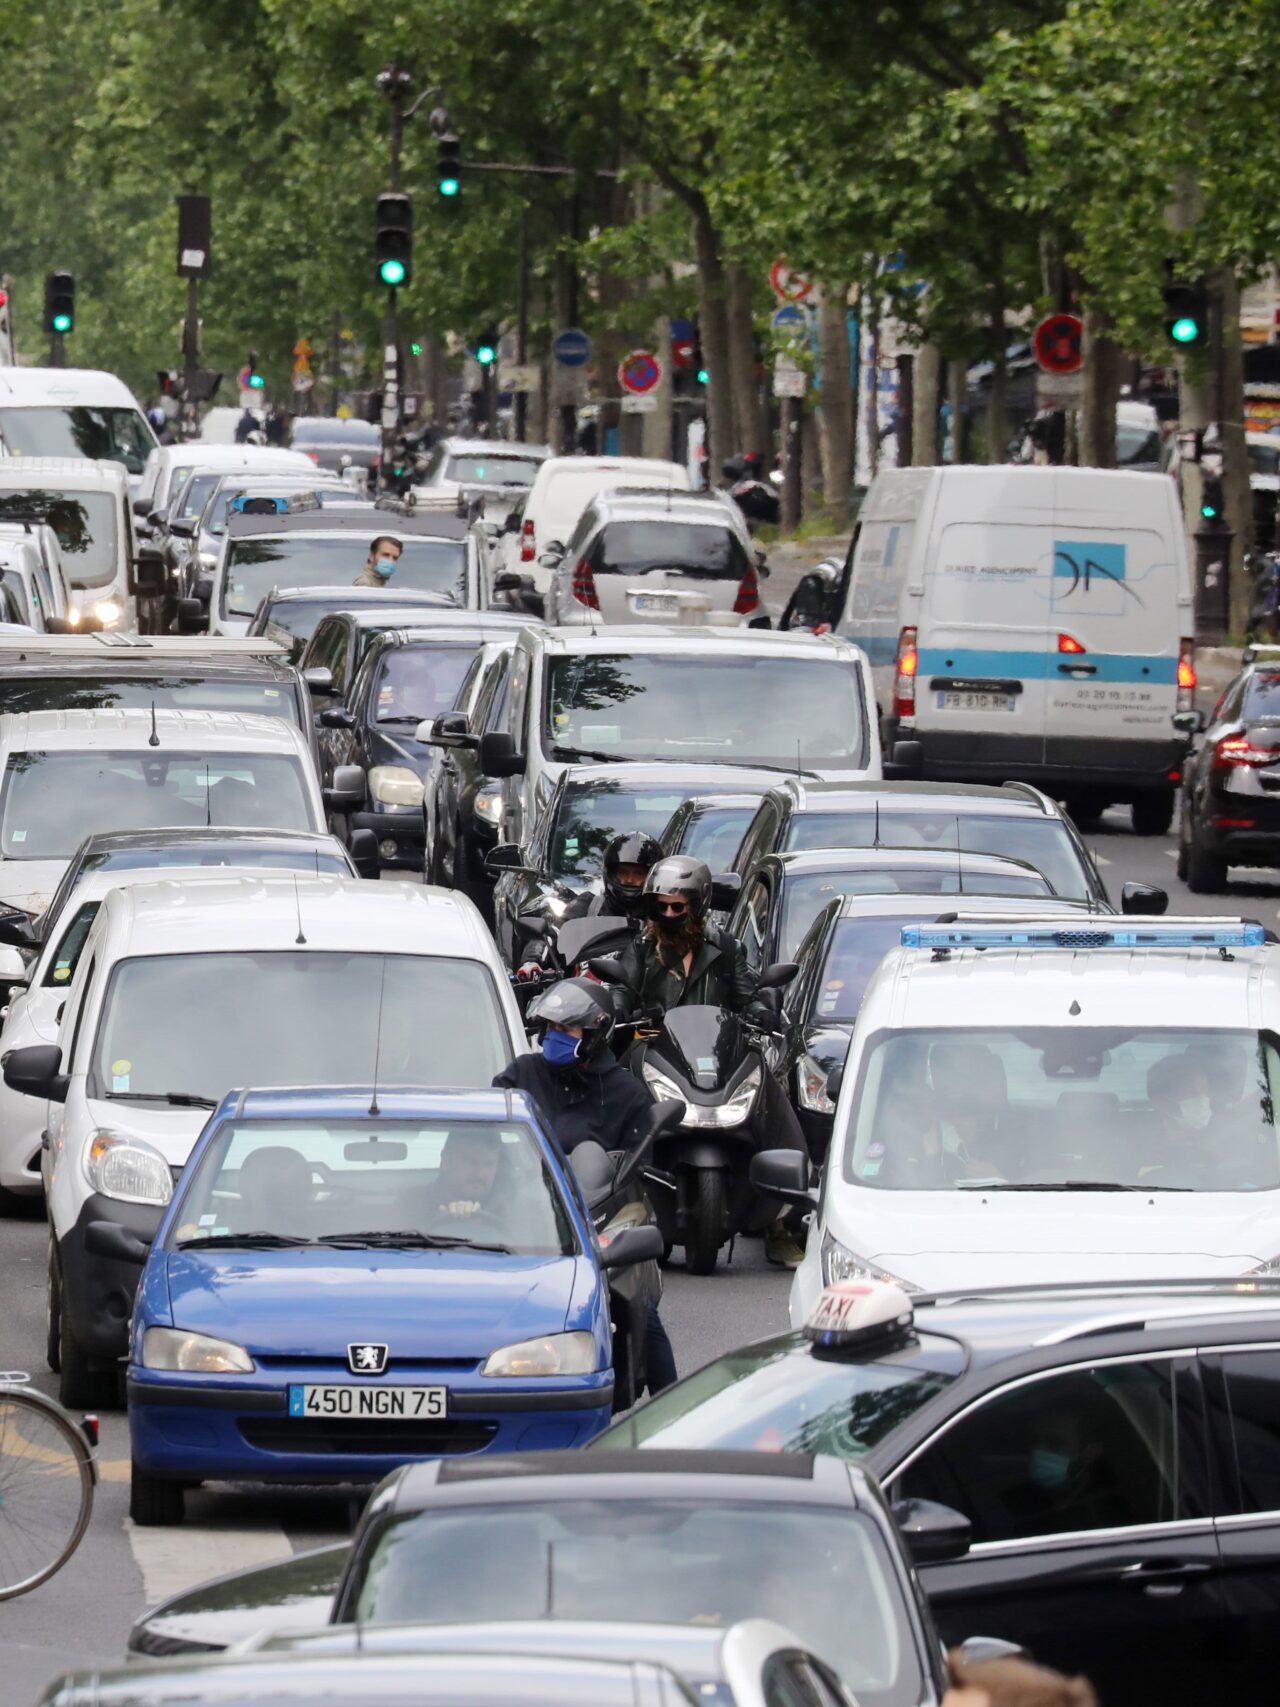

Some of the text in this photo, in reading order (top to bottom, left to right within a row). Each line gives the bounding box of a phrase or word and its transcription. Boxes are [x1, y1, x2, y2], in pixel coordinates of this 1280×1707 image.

[816, 1296, 855, 1318] TAXI
[307, 1389, 352, 1414] 450
[359, 1390, 404, 1415] NGN
[412, 1391, 442, 1415] 75
